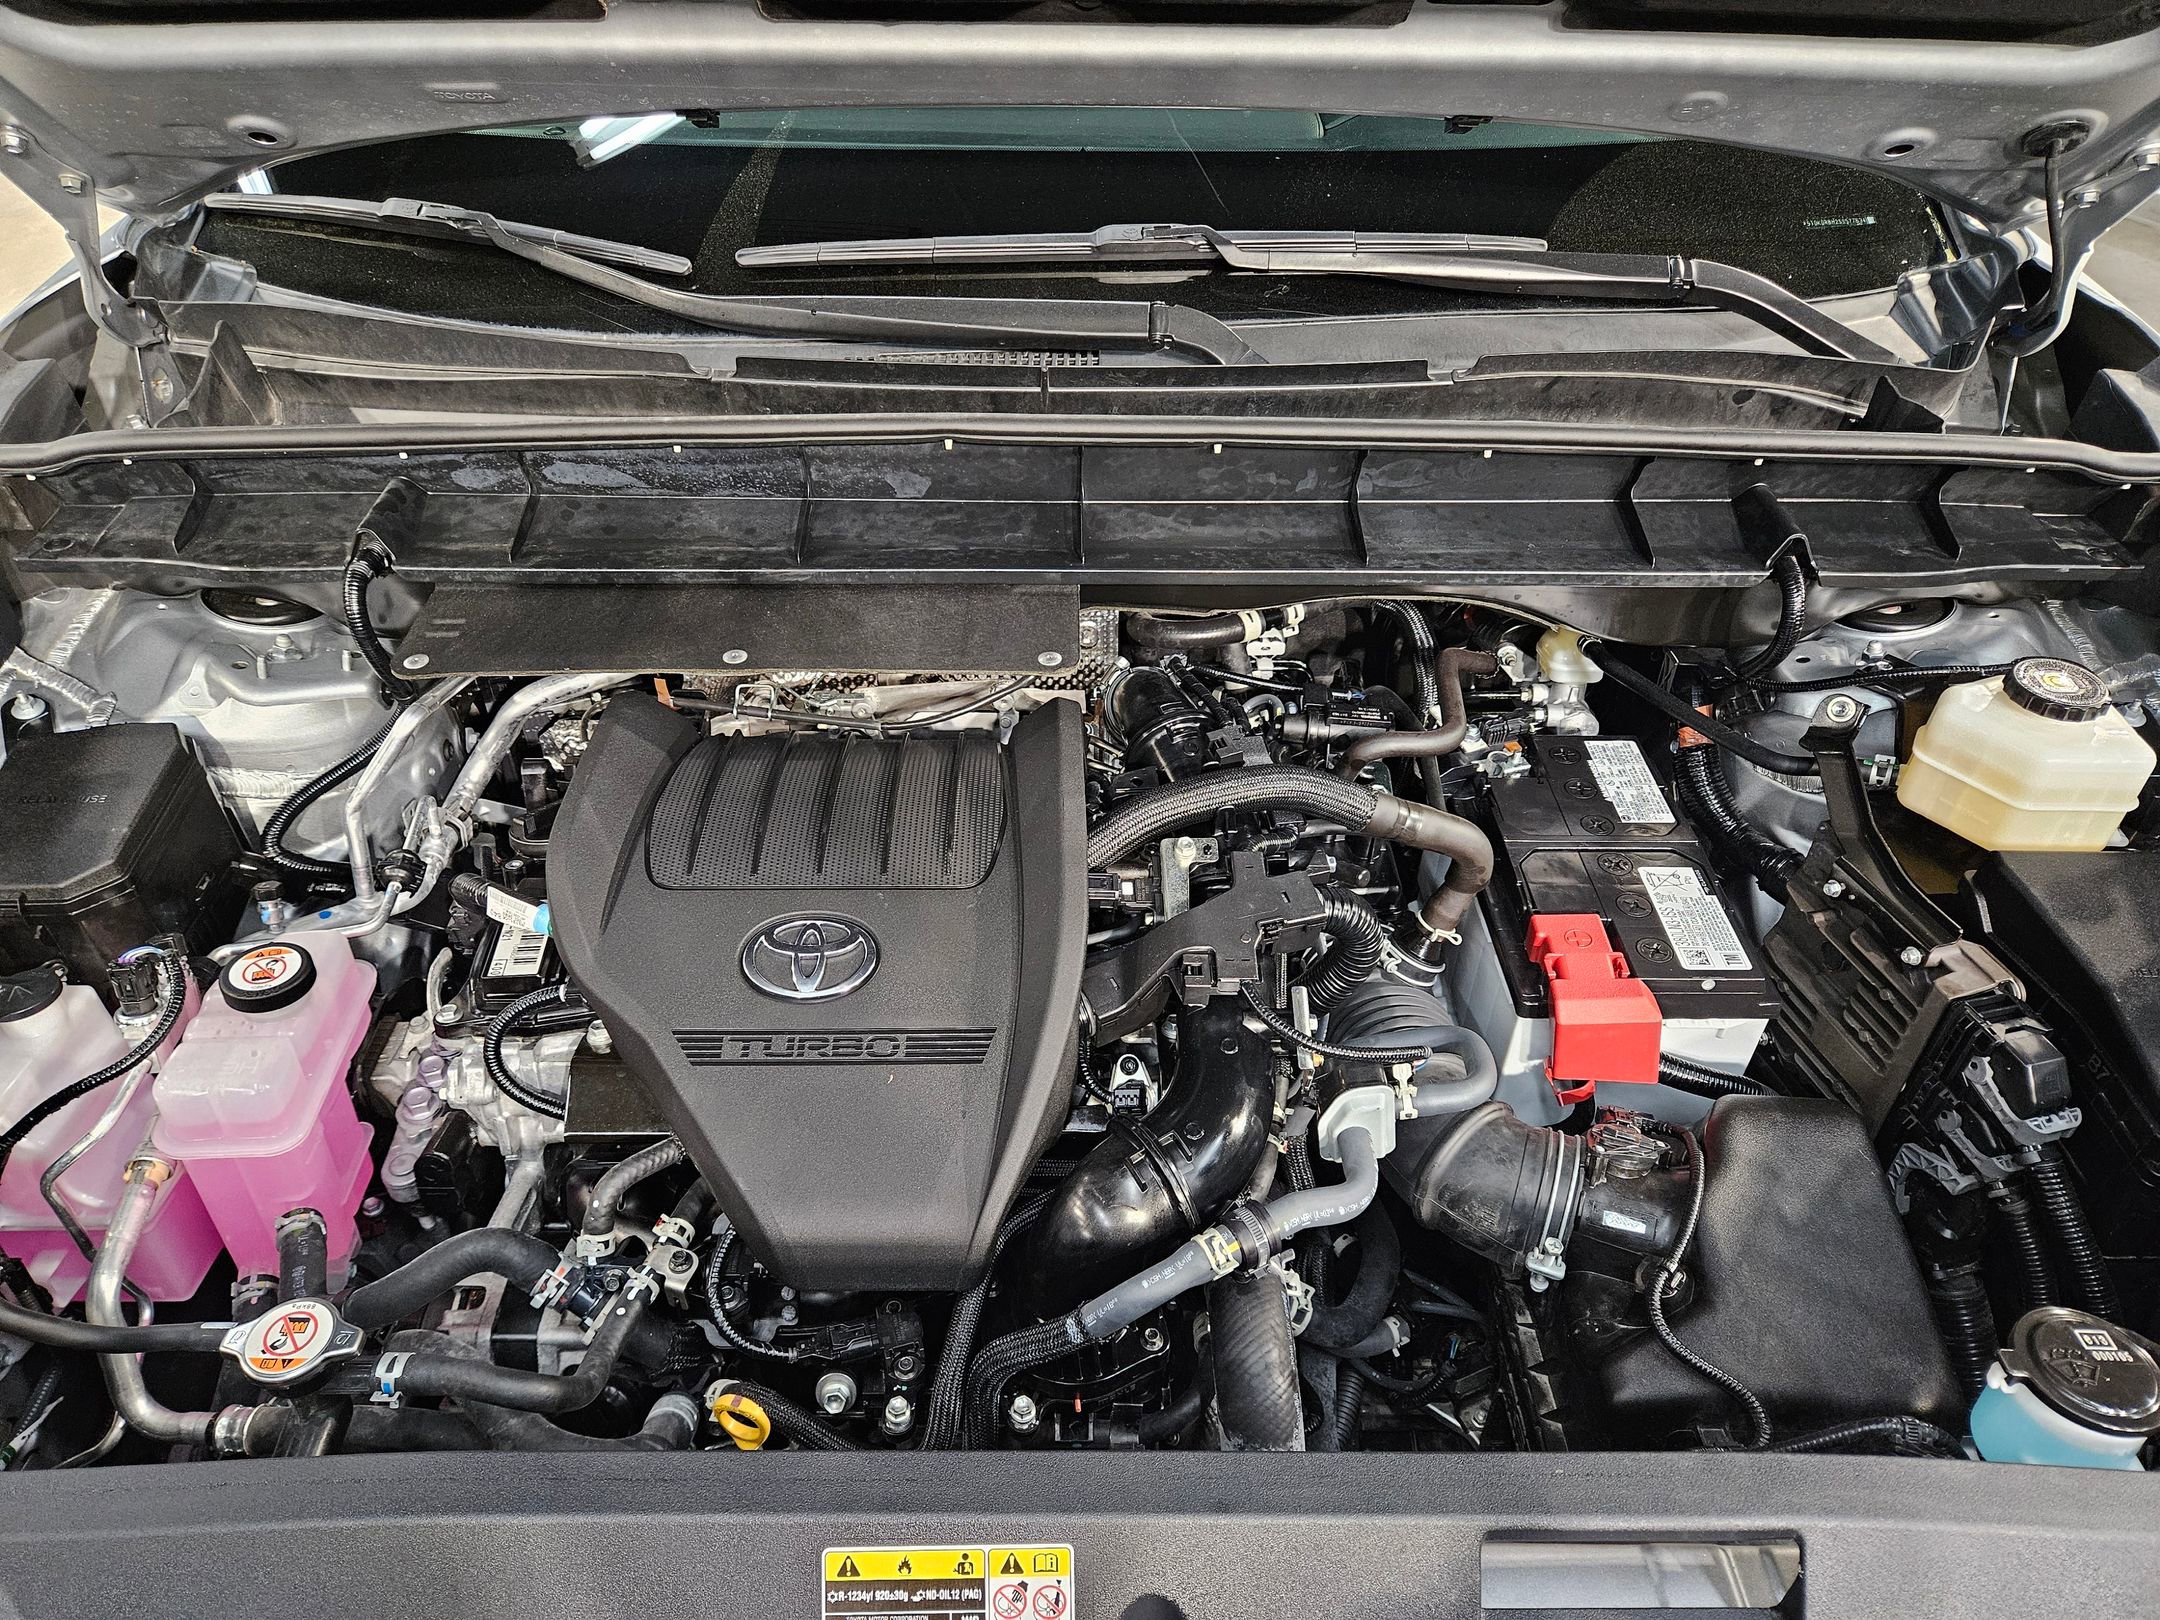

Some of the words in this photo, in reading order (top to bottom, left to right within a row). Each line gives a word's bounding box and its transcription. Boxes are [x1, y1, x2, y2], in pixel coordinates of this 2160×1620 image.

[433, 91, 496, 100] TOYOTA
[1723, 954, 1744, 966] TM
[727, 1035, 901, 1058] TURBO
[2092, 1351, 2133, 1362] 000105
[838, 1589, 873, 1602] R-1234yf
[961, 1588, 983, 1602] (PAG)
